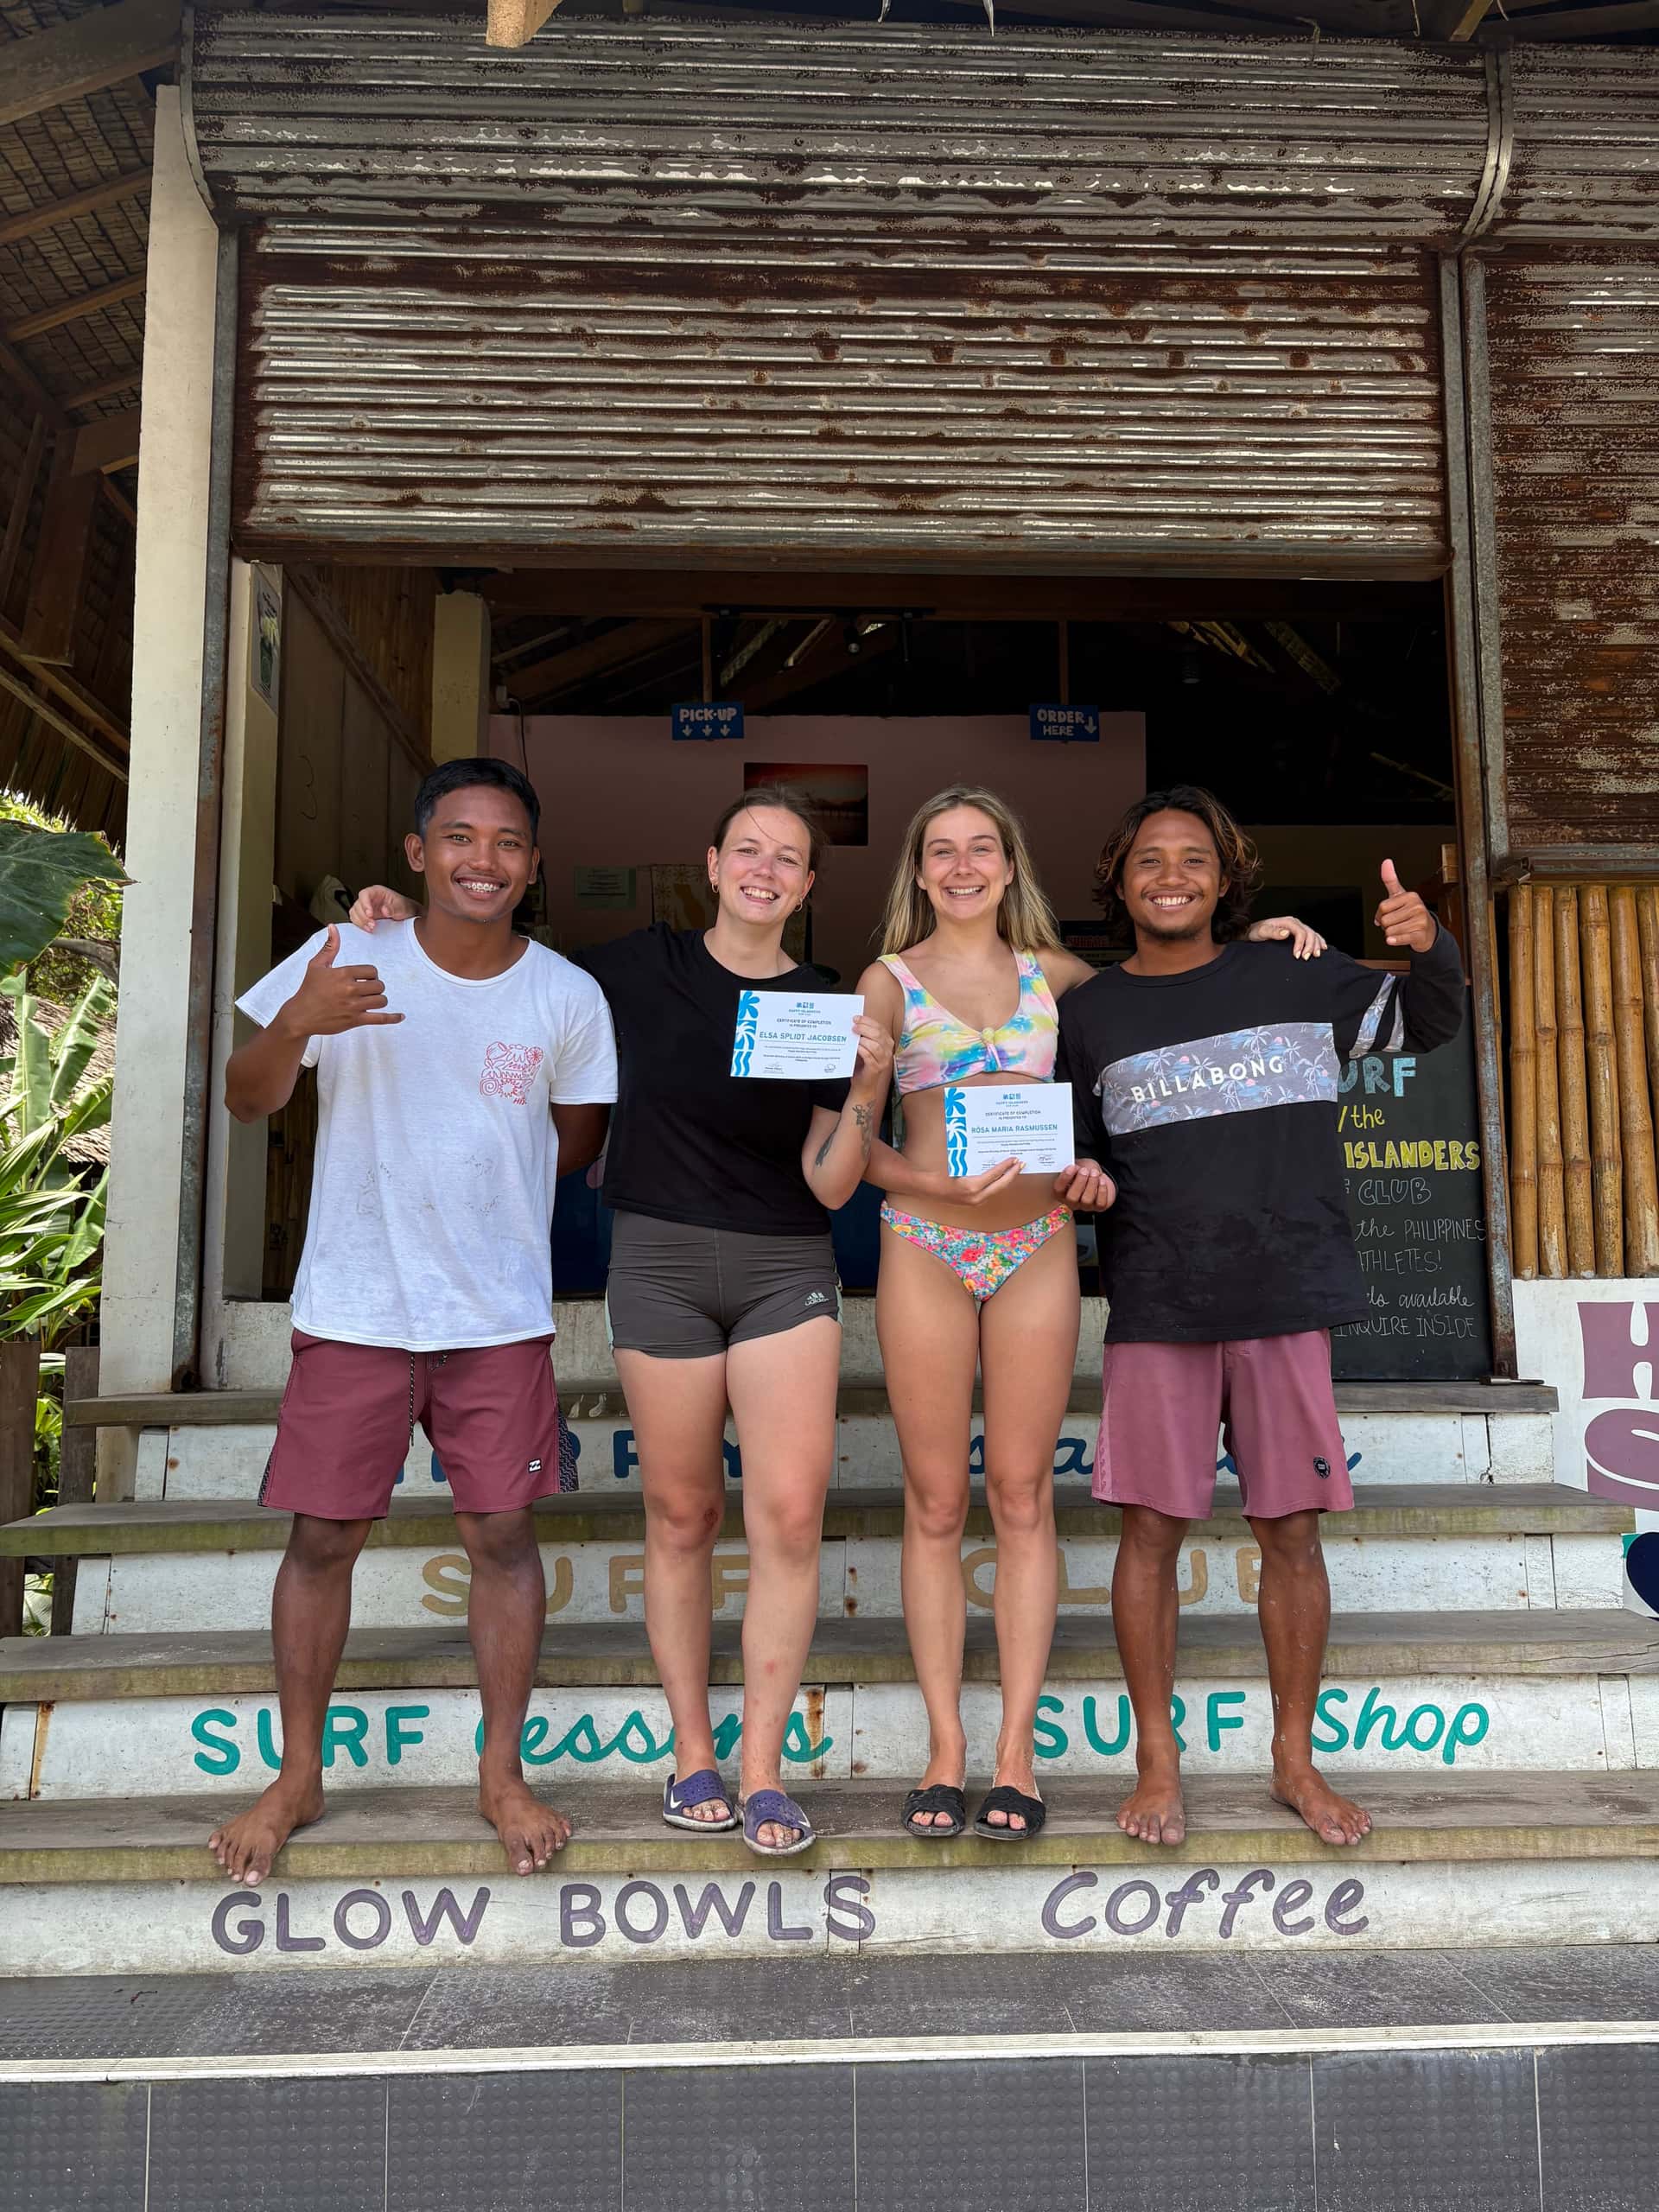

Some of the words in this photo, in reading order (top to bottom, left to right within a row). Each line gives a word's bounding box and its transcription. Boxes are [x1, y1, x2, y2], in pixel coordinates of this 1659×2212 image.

[1037, 709, 1085, 724] ORDER
[1043, 725, 1074, 736] HERE
[1131, 1056, 1283, 1103] BILLABONG
[1338, 1056, 1417, 1098] URF
[1015, 1123, 1058, 1132] RASMUSSEN
[1344, 1141, 1480, 1171] ISLANDERS
[1358, 1177, 1432, 1205] CLUB
[1354, 1218, 1395, 1242] the
[1403, 1218, 1487, 1243] PHILIPPINES
[1399, 1286, 1475, 1308] available
[1416, 1316, 1480, 1338] INSIDE
[191, 1705, 429, 1776] SURF
[1311, 1687, 1490, 1765] Shop
[211, 1886, 493, 1955] GLOW
[560, 1874, 876, 1948] BOWLS
[1041, 1867, 1370, 1941] Coffee
